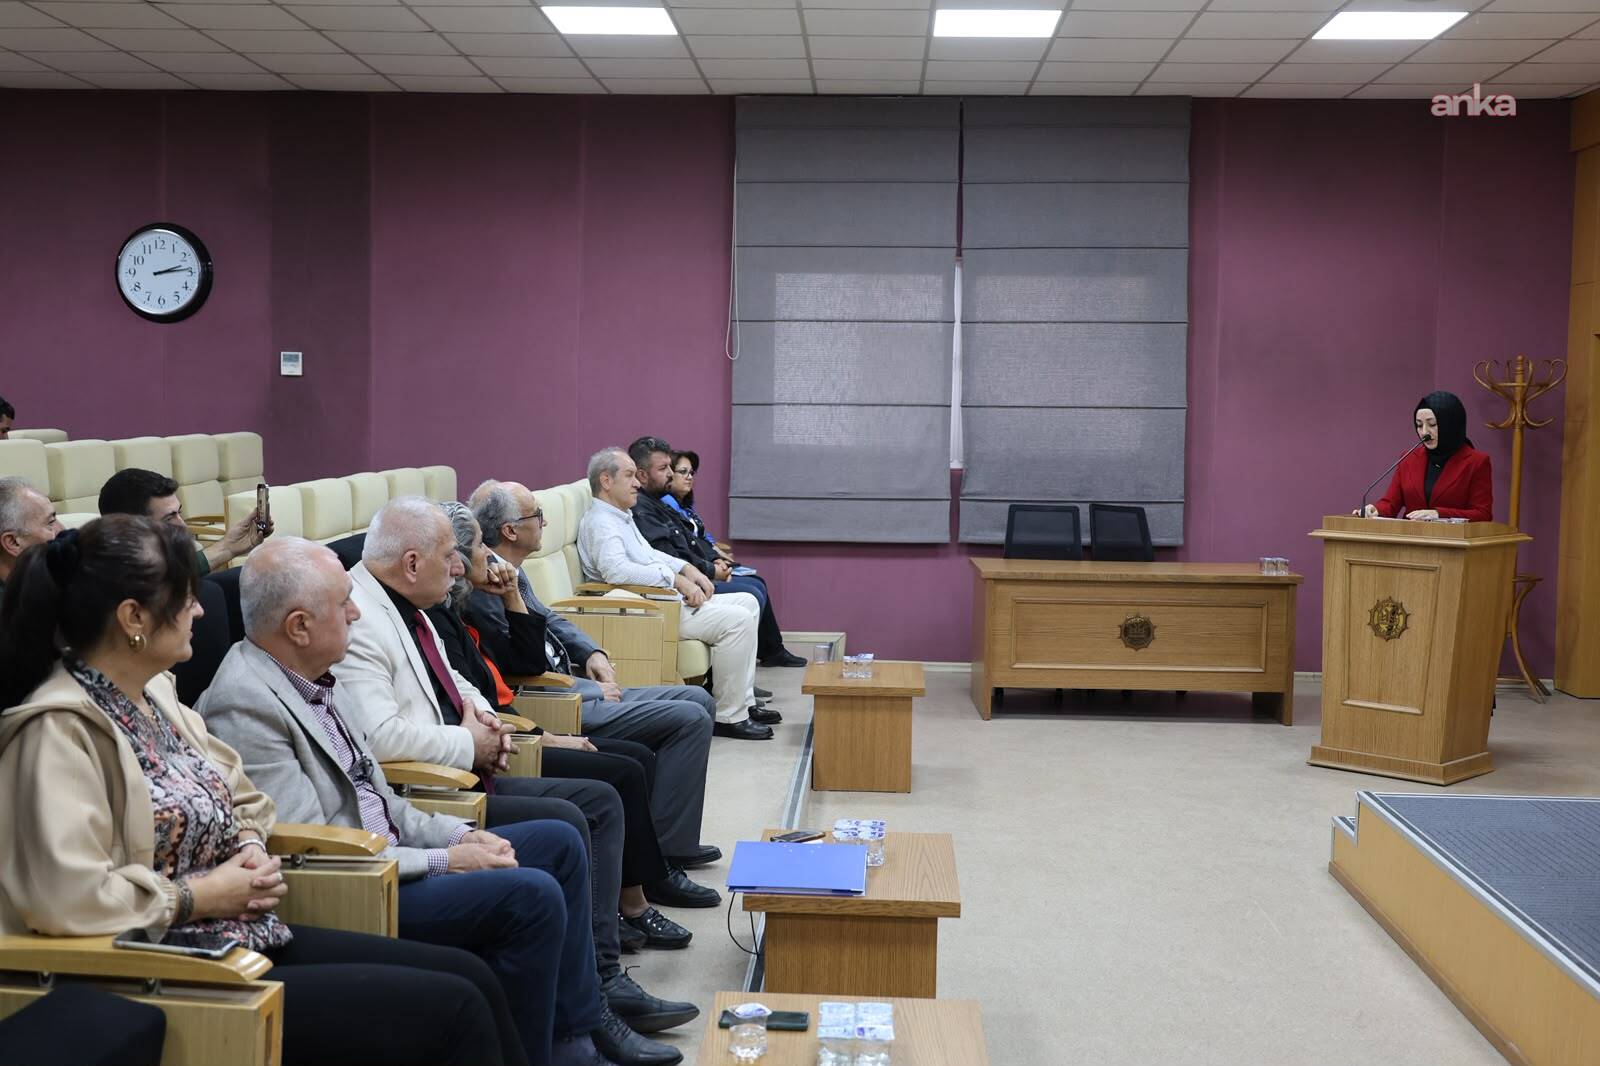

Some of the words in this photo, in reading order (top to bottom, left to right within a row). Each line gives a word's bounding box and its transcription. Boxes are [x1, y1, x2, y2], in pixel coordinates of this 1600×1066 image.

[143, 244, 152, 254] 11
[154, 240, 165, 250] 12
[133, 255, 144, 265] 10
[180, 252, 187, 262] 2
[128, 268, 136, 278] 9
[133, 282, 141, 292] 8
[182, 281, 189, 291] 4
[145, 291, 152, 302] 7
[158, 295, 165, 305] 6
[174, 291, 180, 302] 5
